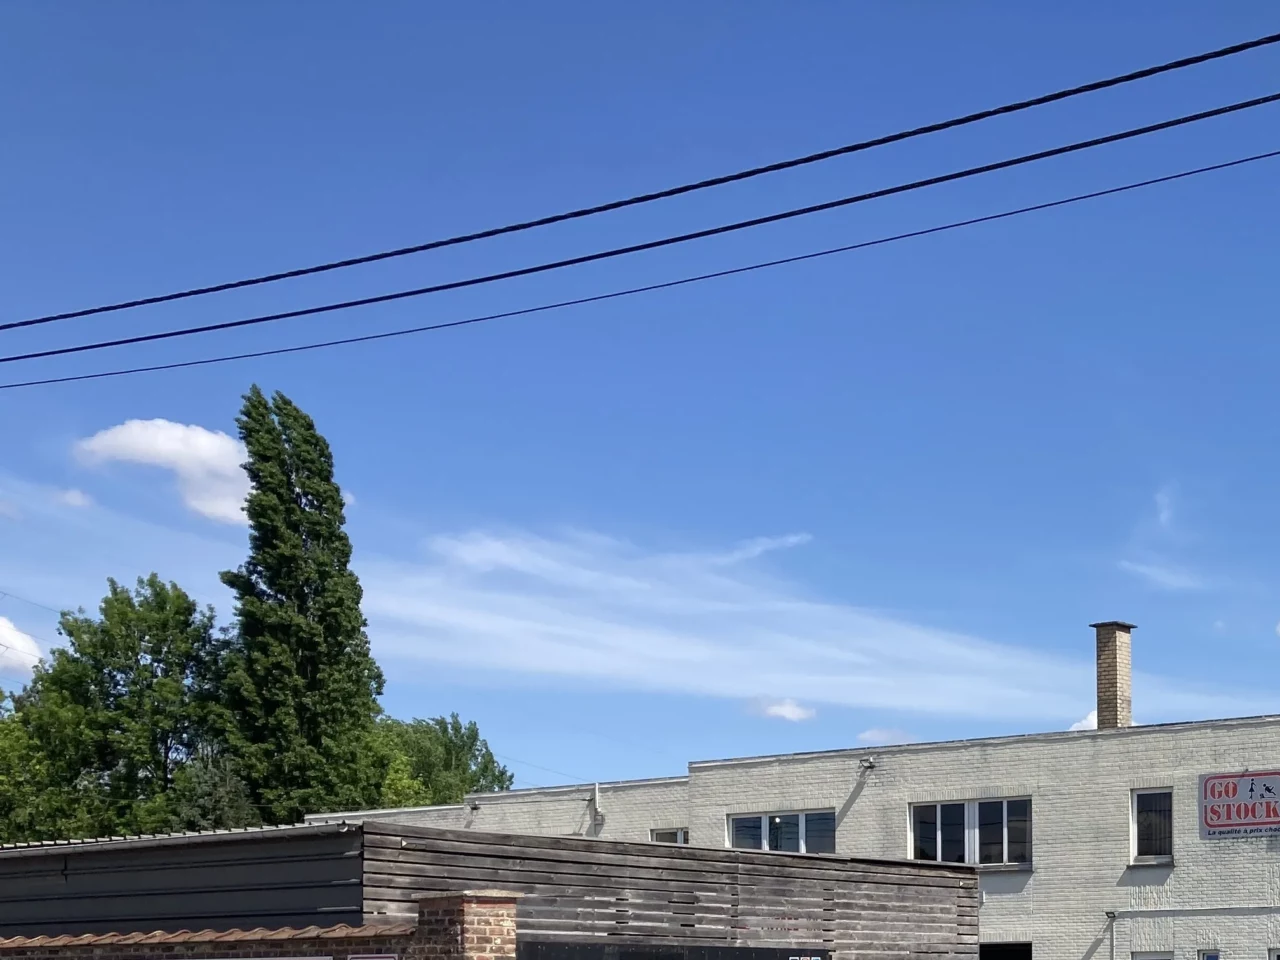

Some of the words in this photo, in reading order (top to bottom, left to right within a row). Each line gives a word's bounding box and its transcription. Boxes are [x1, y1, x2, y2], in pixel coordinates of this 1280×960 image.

[1210, 781, 1238, 799] GO
[1210, 801, 1280, 821] STOCK
[1249, 827, 1263, 835] prix
